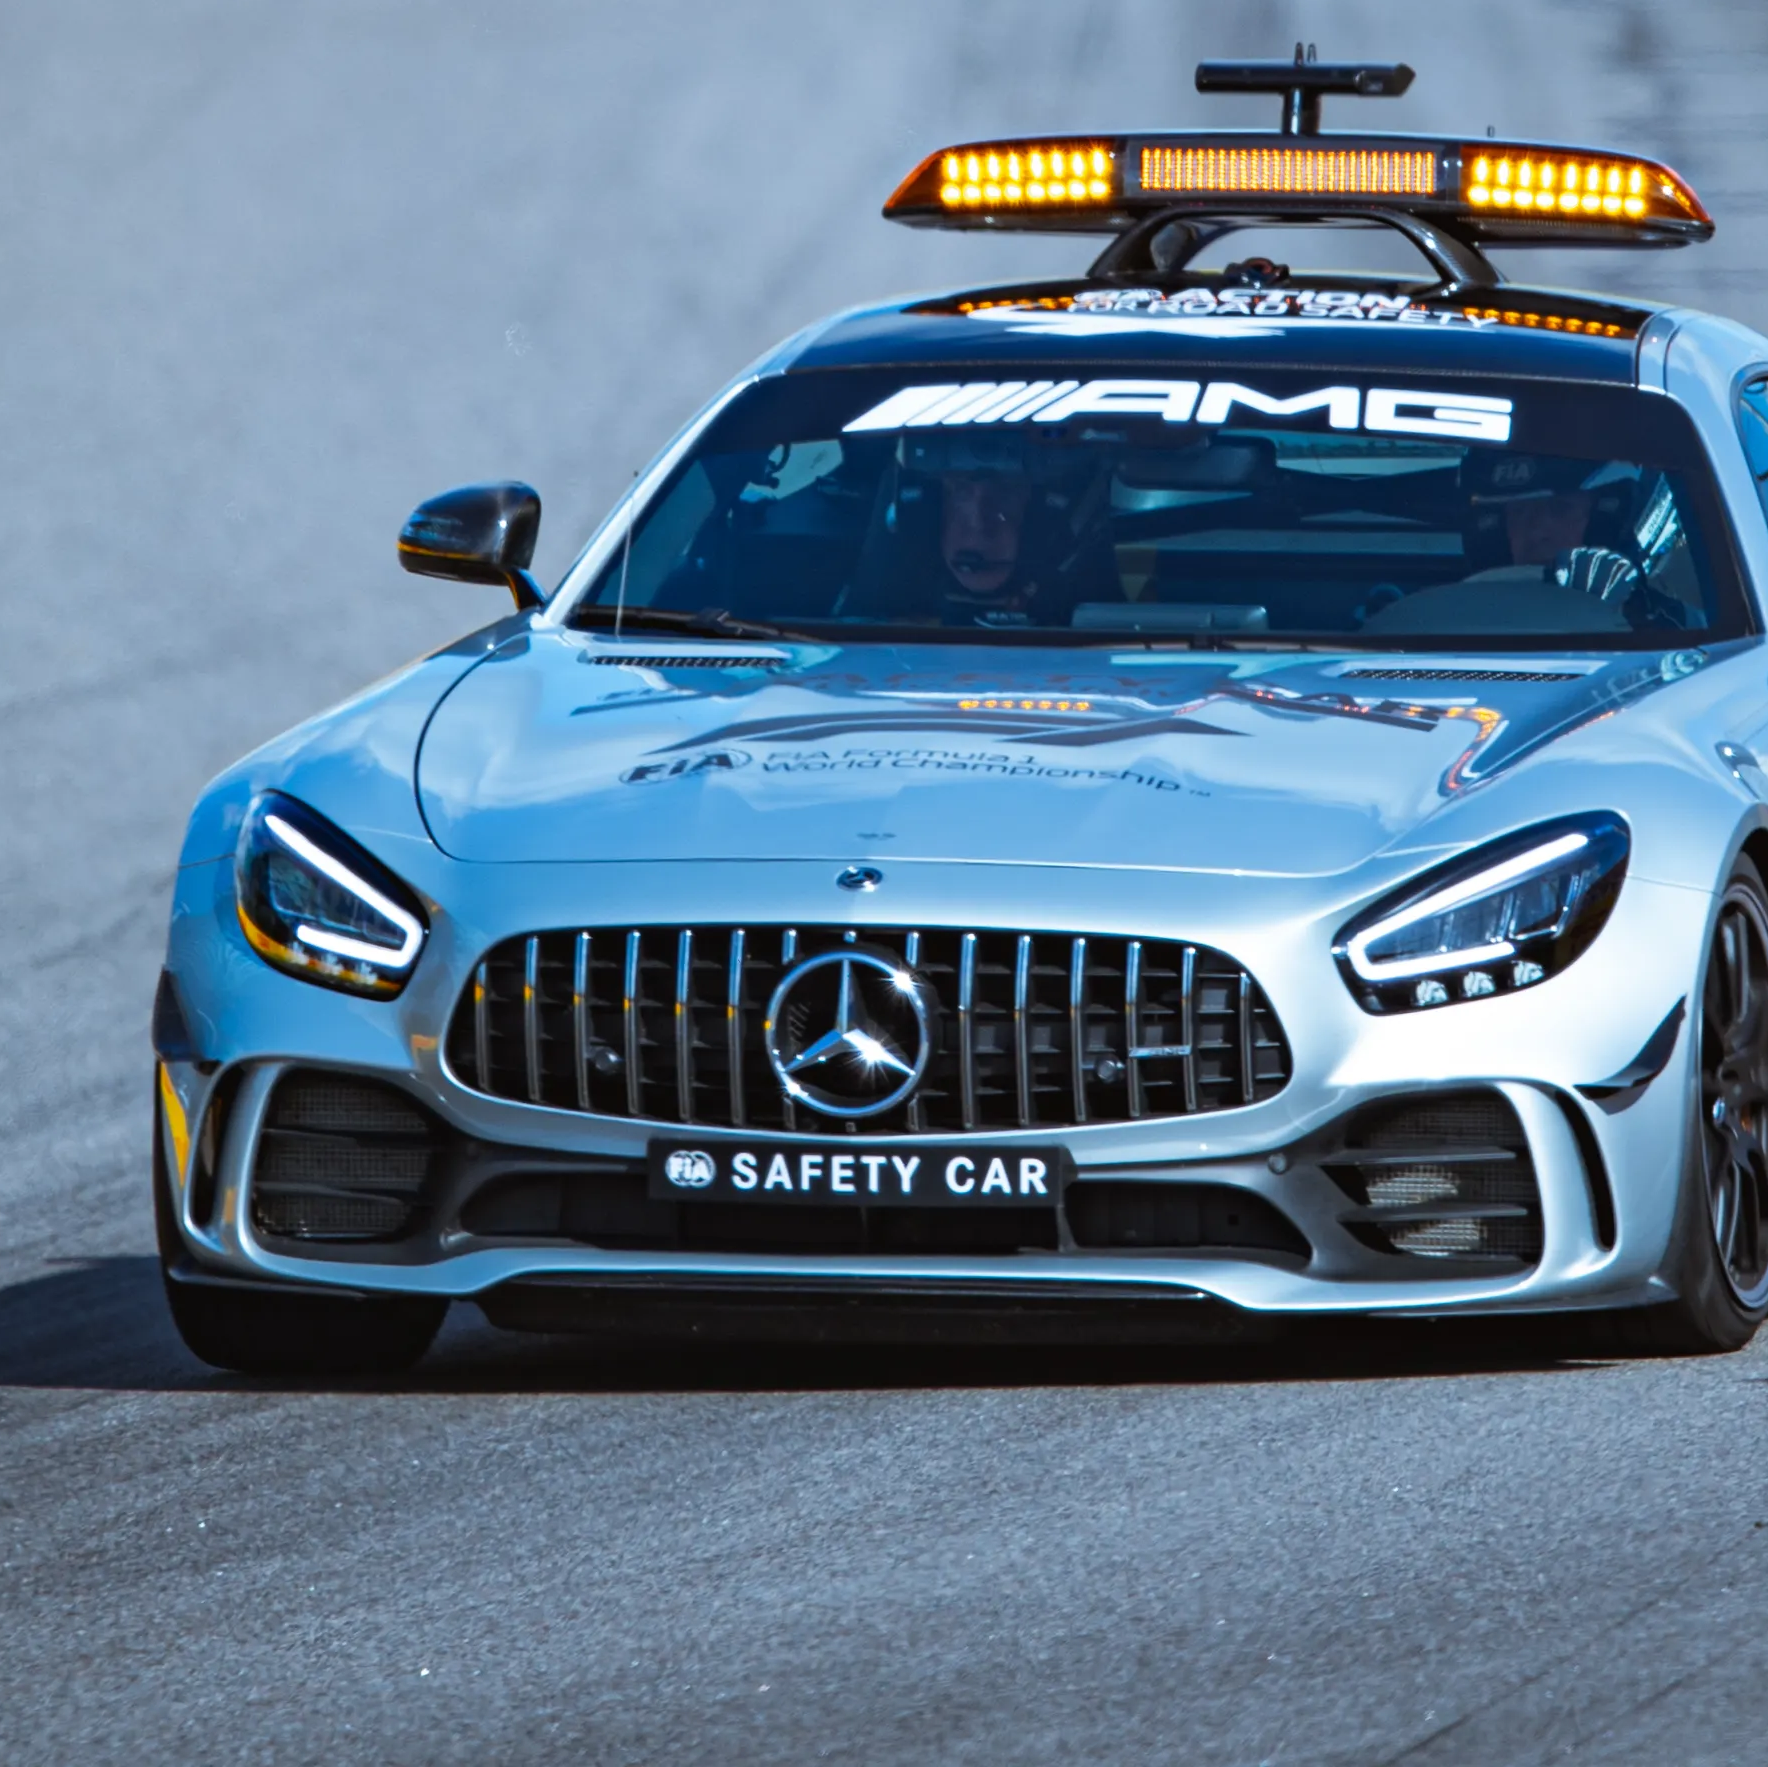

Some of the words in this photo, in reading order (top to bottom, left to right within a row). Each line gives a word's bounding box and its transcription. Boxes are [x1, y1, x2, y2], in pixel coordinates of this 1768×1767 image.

[1299, 303, 1499, 328] SAFETY
[628, 752, 734, 781] FIA
[842, 749, 1010, 763] Formula
[762, 758, 881, 772] World
[890, 757, 1181, 792] Championship
[731, 1152, 921, 1193] SAFETY
[945, 1156, 1048, 1195] CAR
